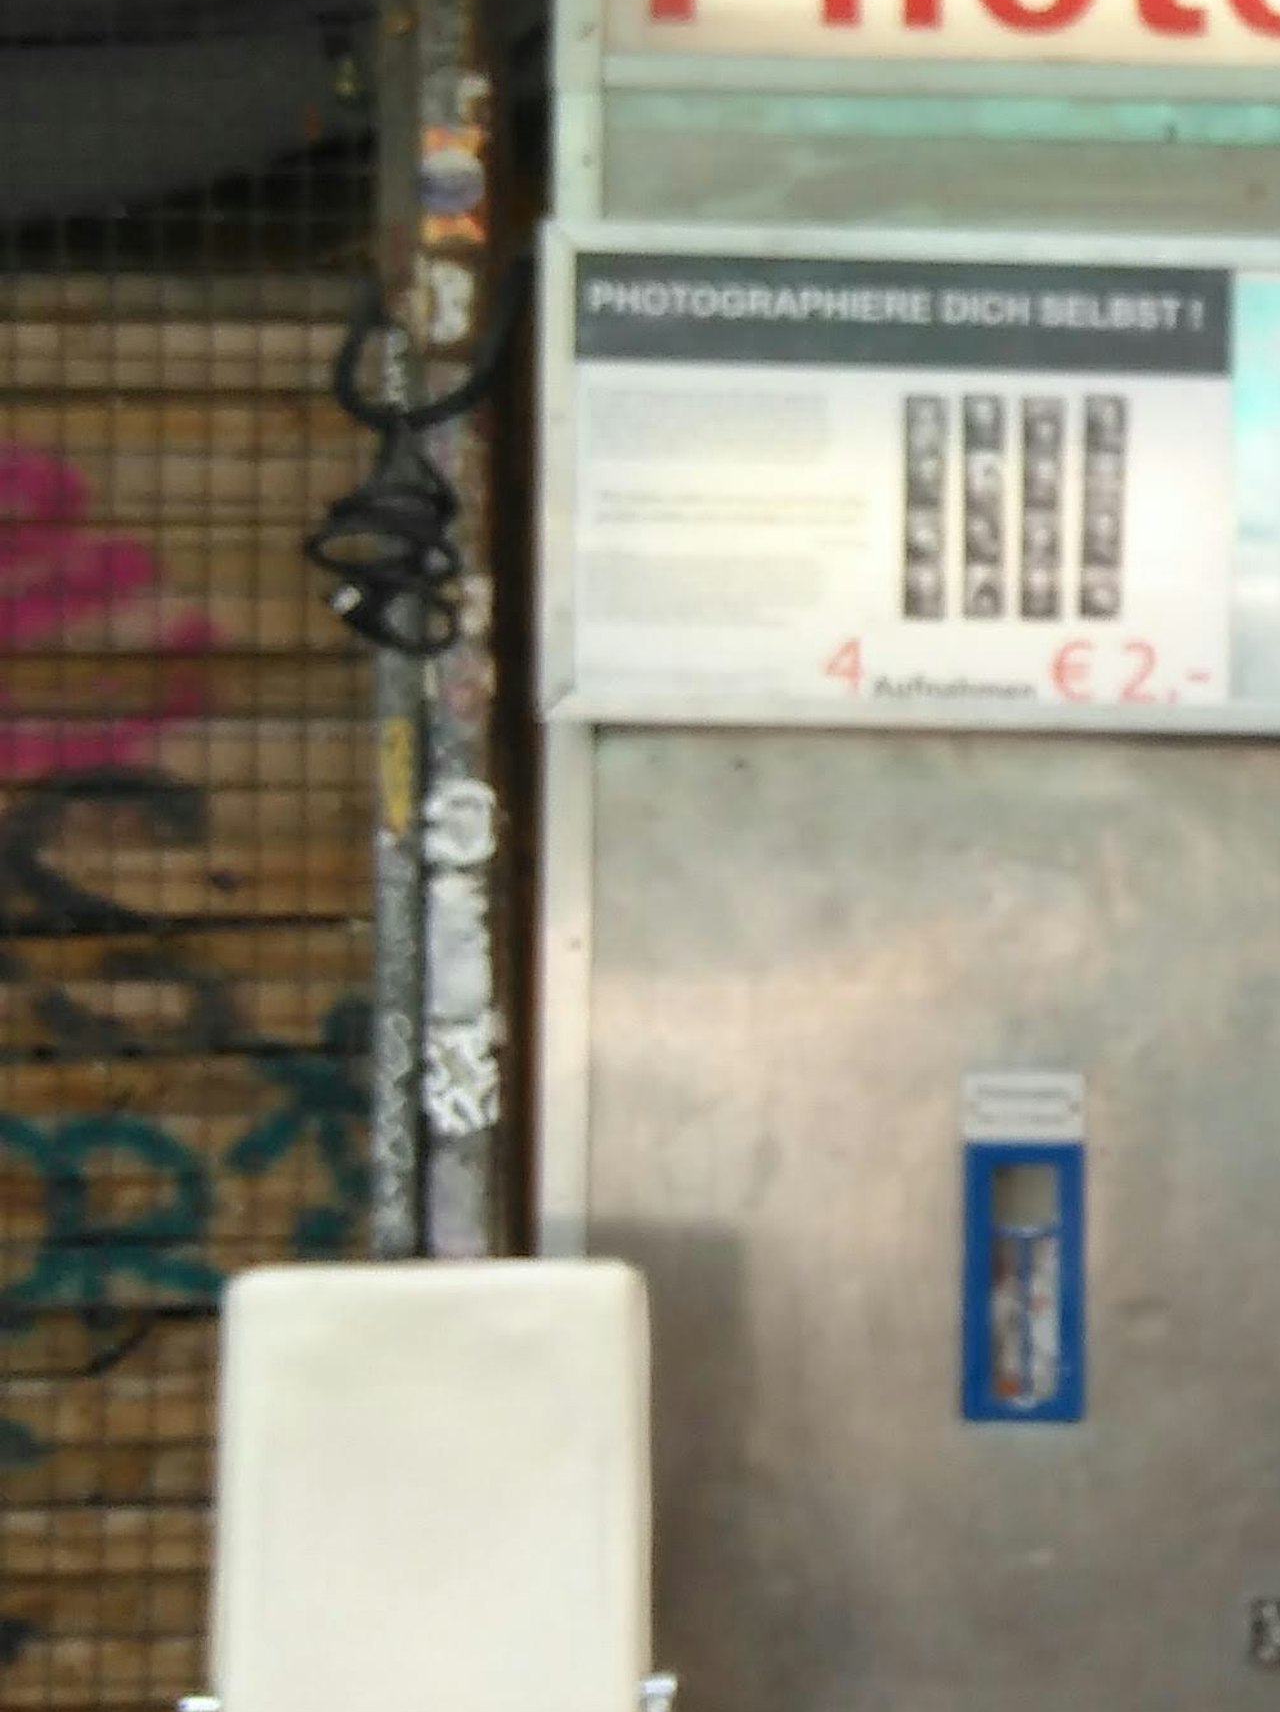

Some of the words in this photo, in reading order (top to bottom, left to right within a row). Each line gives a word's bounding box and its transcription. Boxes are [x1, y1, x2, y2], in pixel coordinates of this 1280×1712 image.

[588, 279, 931, 325] PHOTOGRAPHIERE
[944, 291, 1031, 326] DICH
[1041, 293, 1181, 330] SELBST
[821, 636, 863, 697] 4
[1049, 638, 1095, 703] €
